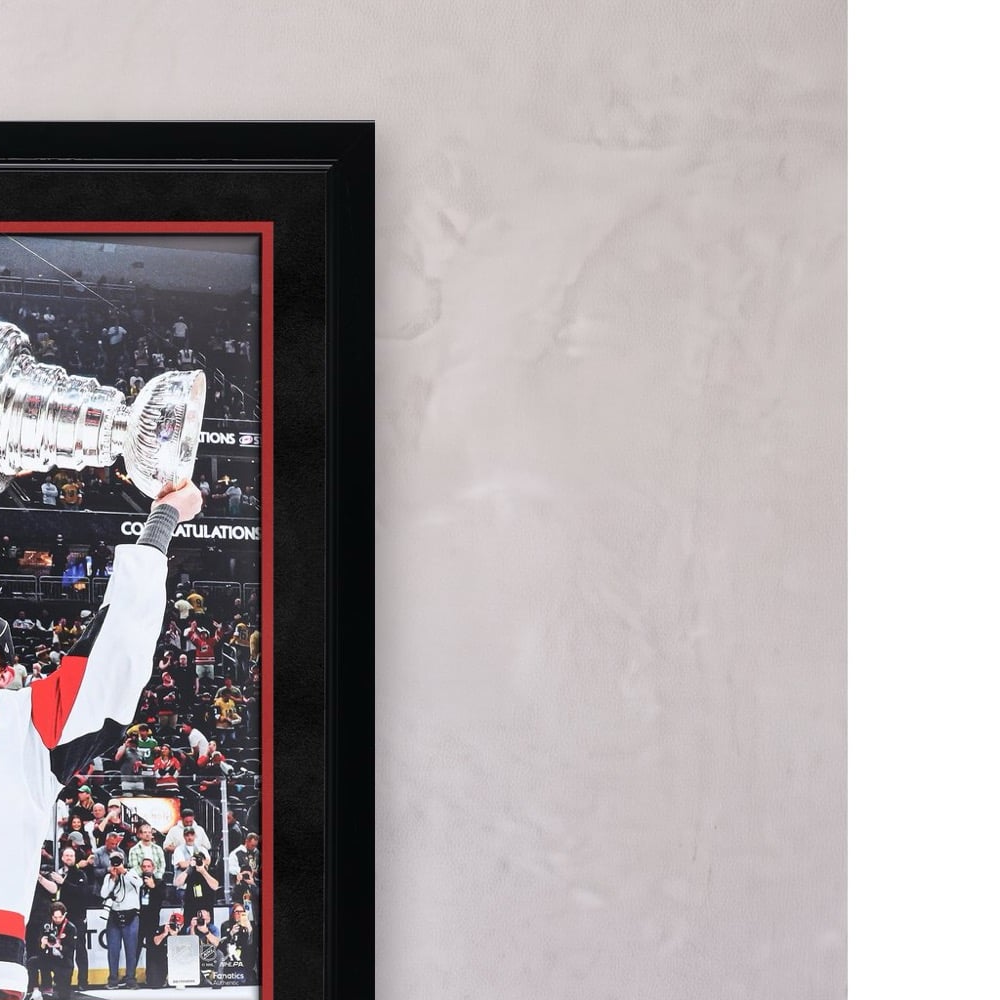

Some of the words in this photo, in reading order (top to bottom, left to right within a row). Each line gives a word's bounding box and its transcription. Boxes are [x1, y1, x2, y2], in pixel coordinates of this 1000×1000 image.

[199, 432, 236, 445] TIONS
[121, 522, 260, 541] COATULATIONS
[213, 971, 245, 980] Fanatics
